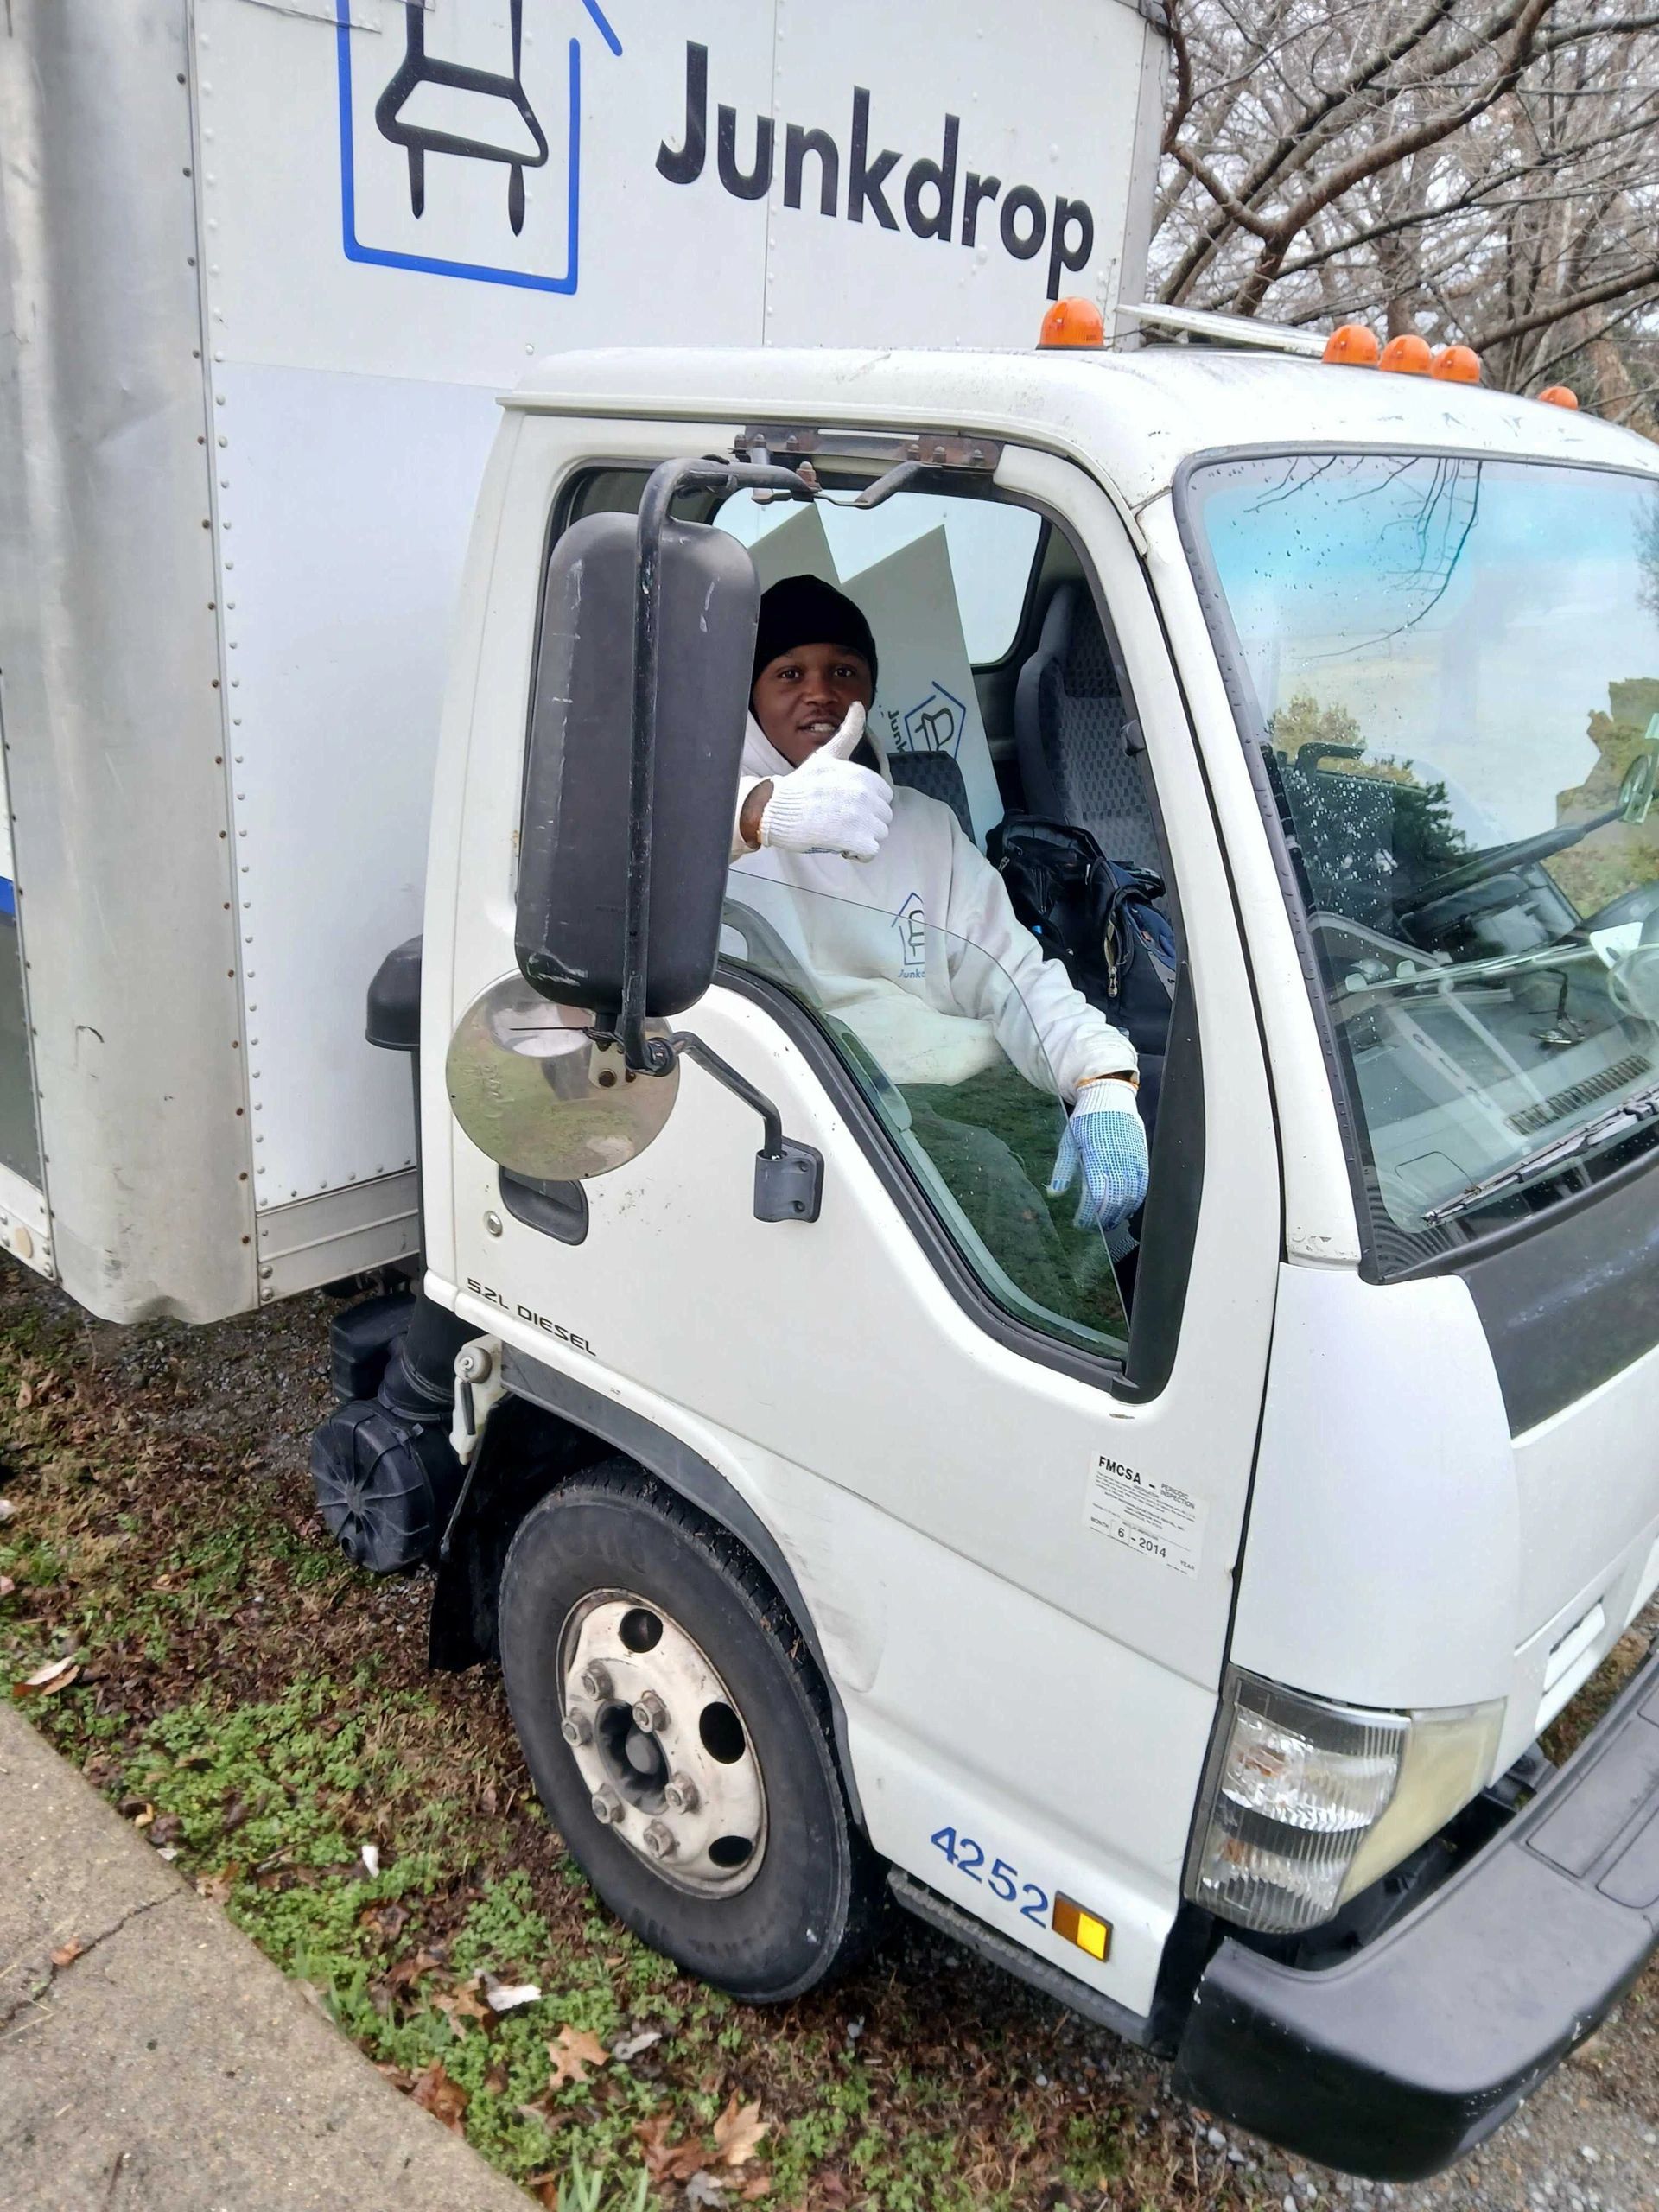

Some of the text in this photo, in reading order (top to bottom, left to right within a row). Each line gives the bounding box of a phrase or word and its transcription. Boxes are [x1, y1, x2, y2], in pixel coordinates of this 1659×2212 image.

[655, 40, 1094, 300] Junkdrop
[517, 1303, 597, 1357] DIESEL
[1098, 1456, 1141, 1485] FMCSA
[1117, 1527, 1125, 1538] 6
[1139, 1537, 1166, 1558] 2014
[1179, 1560, 1195, 1571] YEAR
[931, 1826, 1048, 1929] 4252
